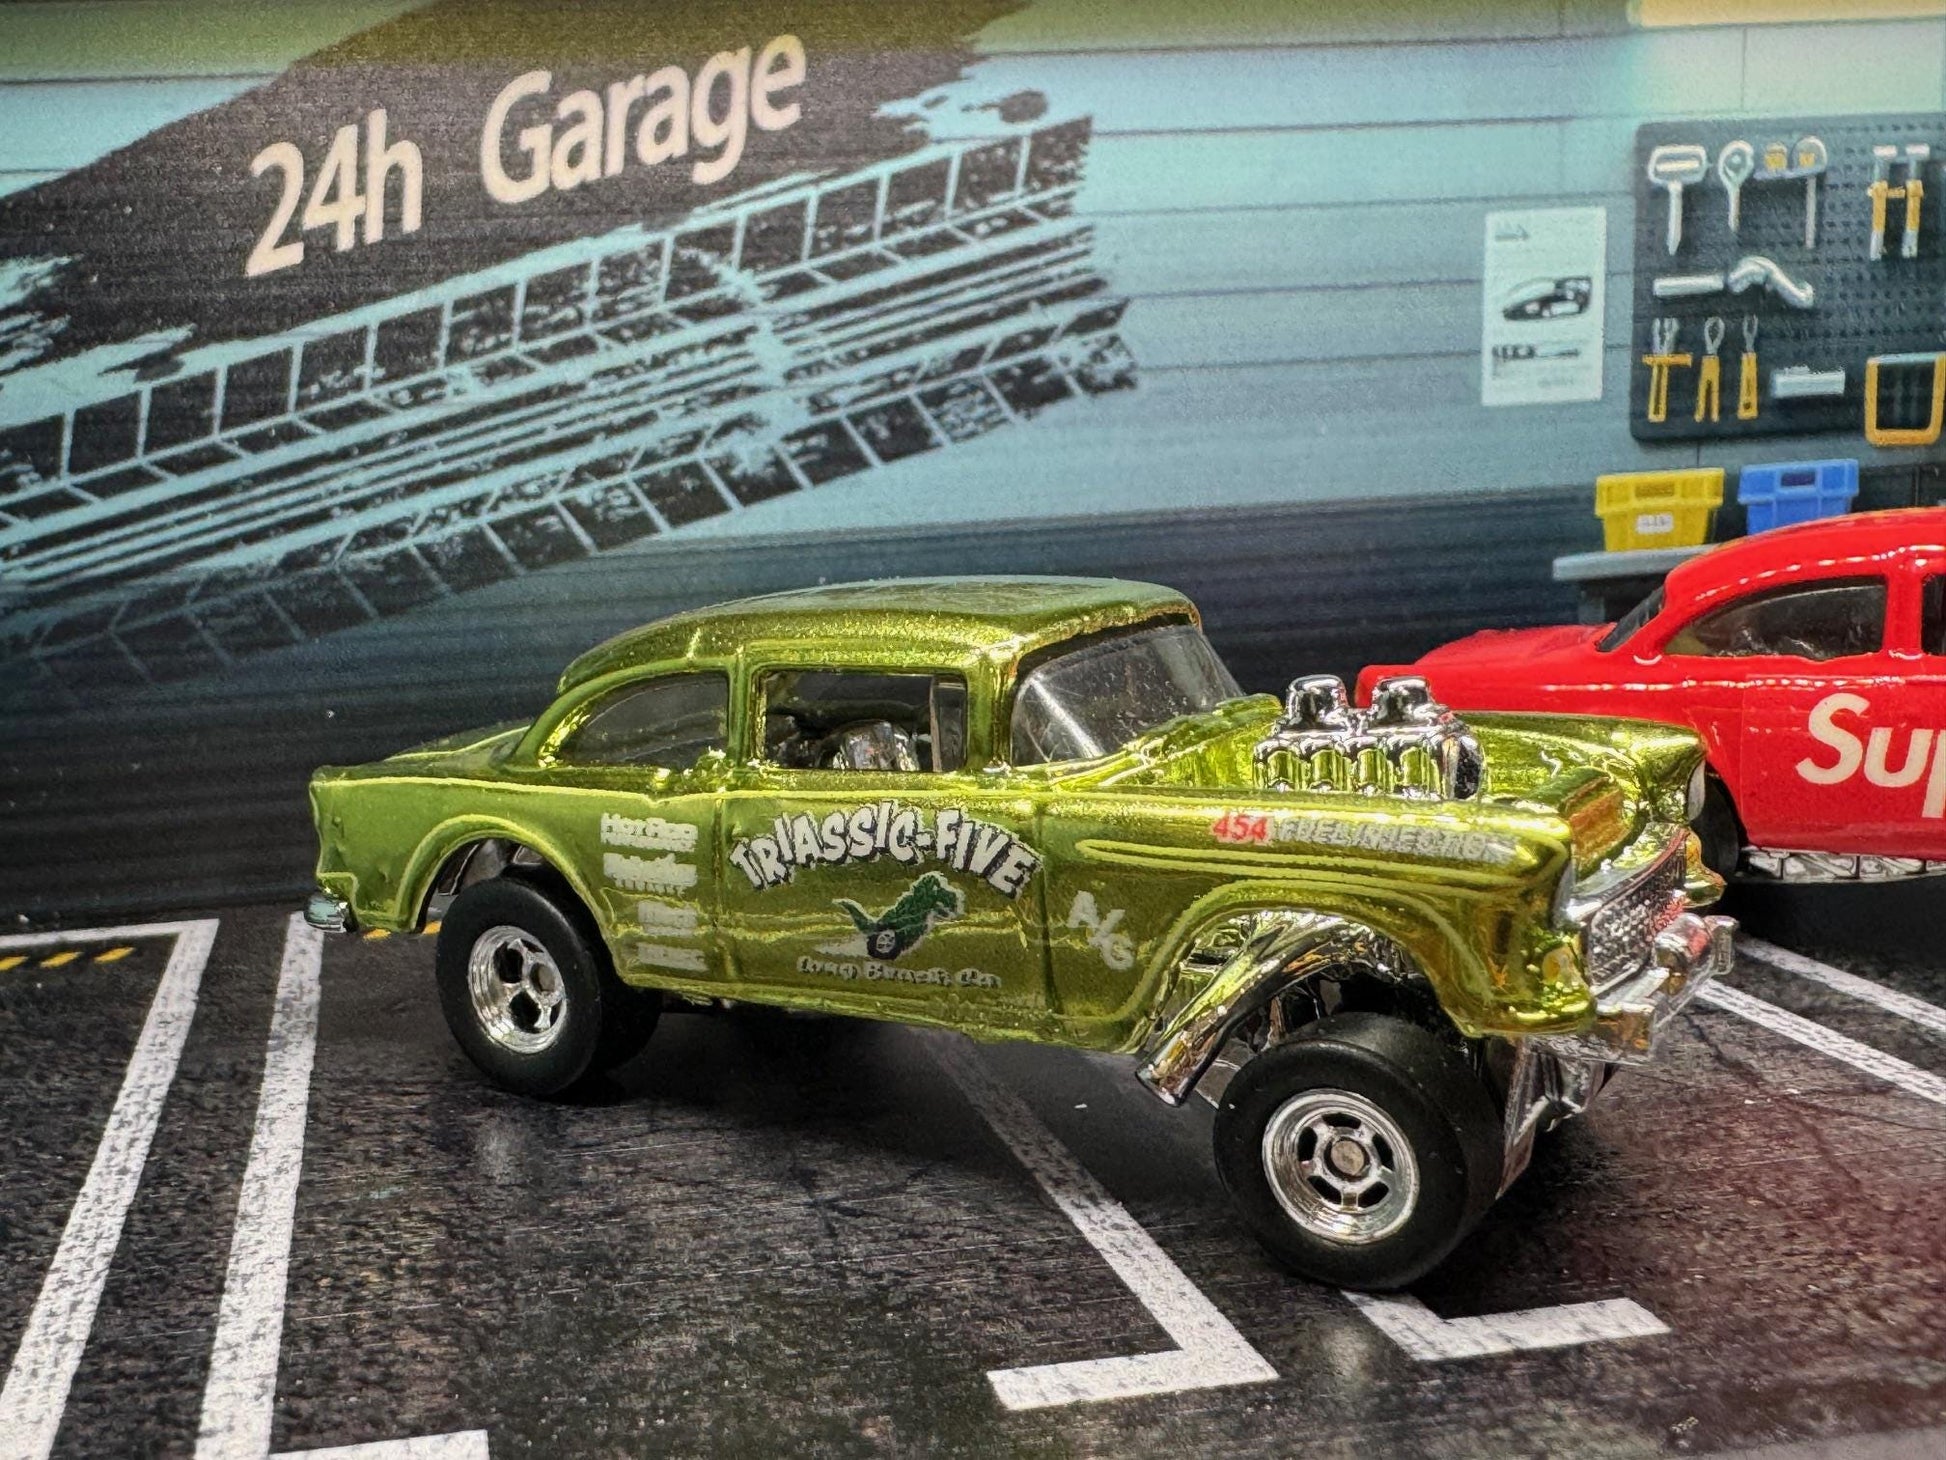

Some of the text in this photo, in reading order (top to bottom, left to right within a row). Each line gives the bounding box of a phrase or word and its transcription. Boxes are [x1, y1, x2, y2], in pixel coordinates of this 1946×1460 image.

[245, 34, 808, 277] 24h Garage
[728, 800, 1044, 898] TRIASSIC-FIVE
[1212, 811, 1271, 846] 454
